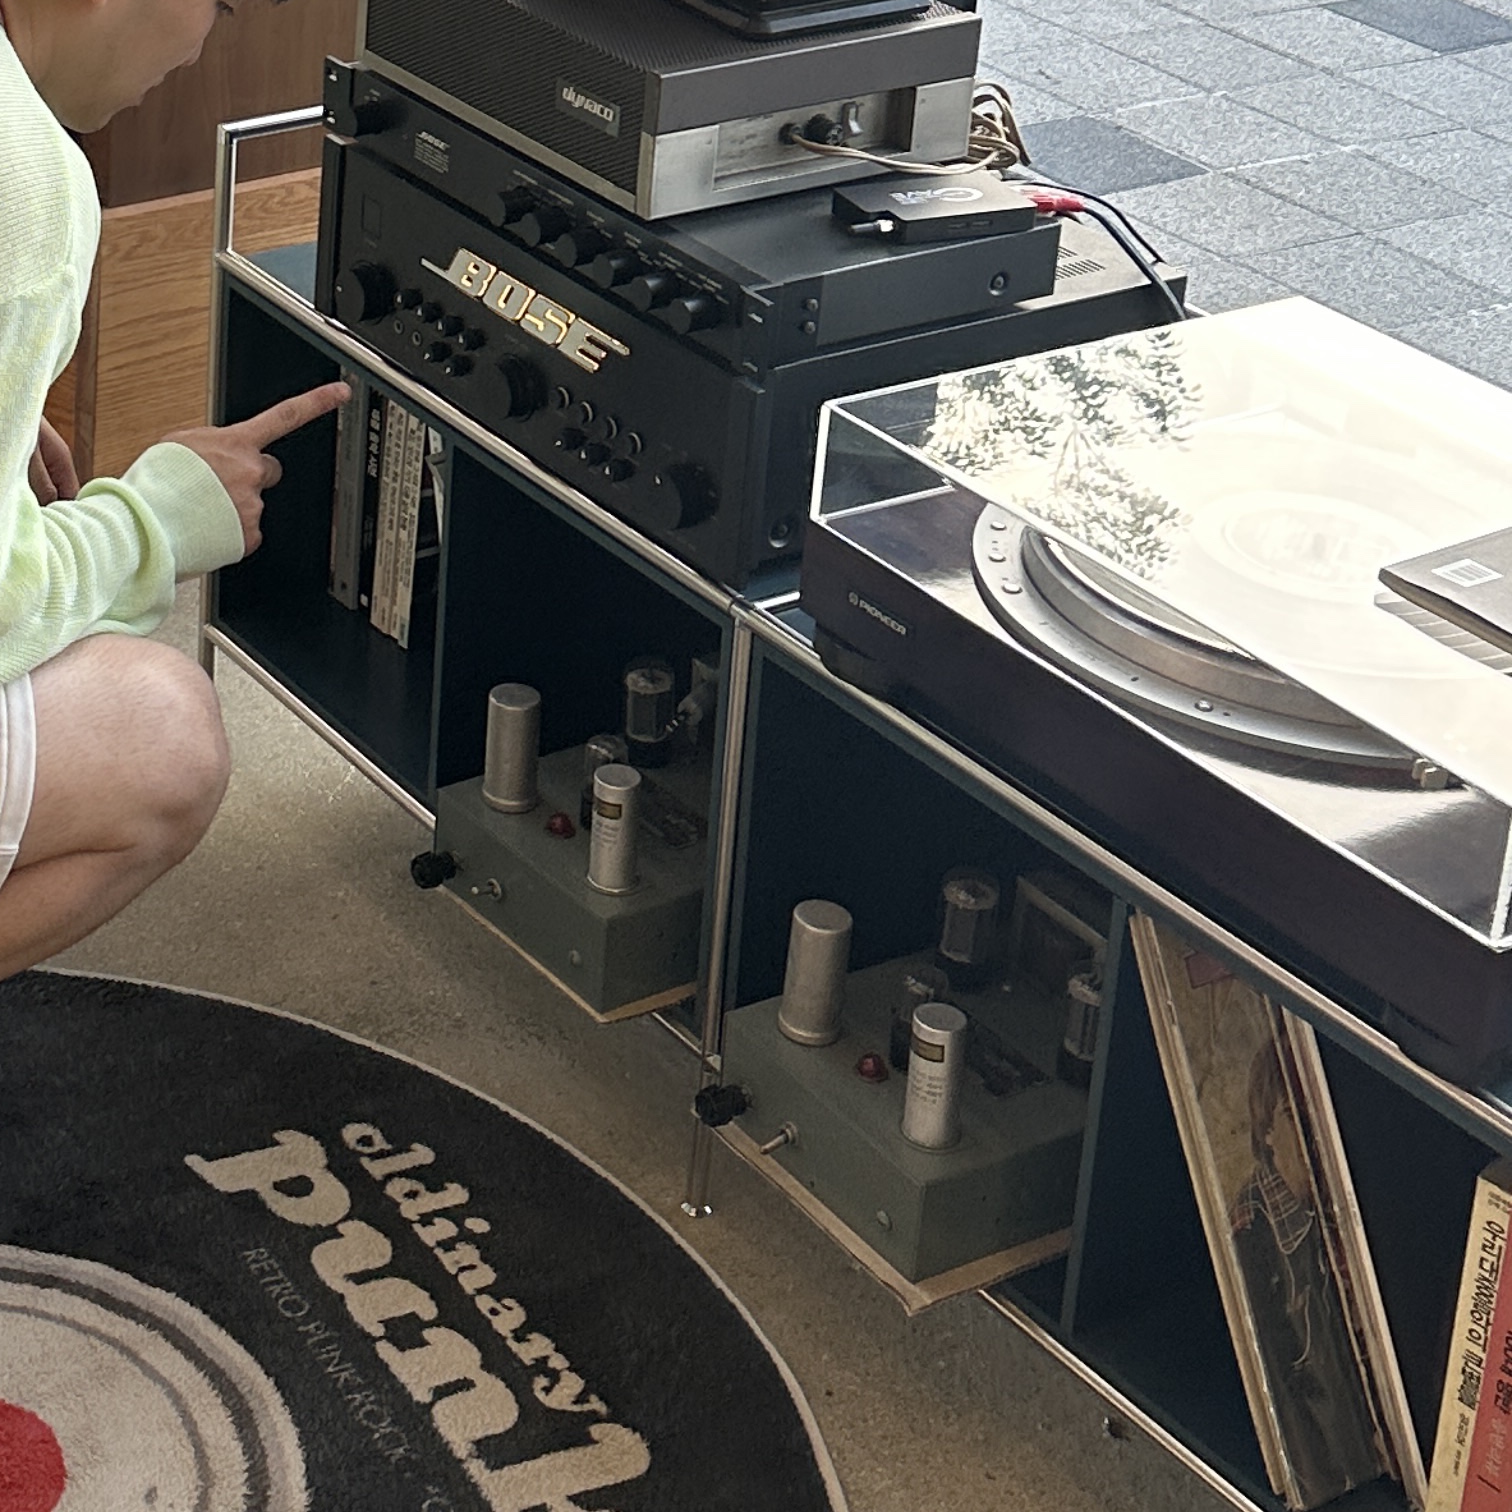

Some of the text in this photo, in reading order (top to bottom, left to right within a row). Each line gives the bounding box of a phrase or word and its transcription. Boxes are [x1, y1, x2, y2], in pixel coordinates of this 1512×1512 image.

[562, 86, 614, 122] dynaco
[420, 247, 631, 374] BOSE
[858, 599, 906, 635] PIONEER
[242, 1247, 311, 1318] RETRO
[296, 1321, 364, 1391] PUNK
[340, 1121, 610, 1418] oldinary
